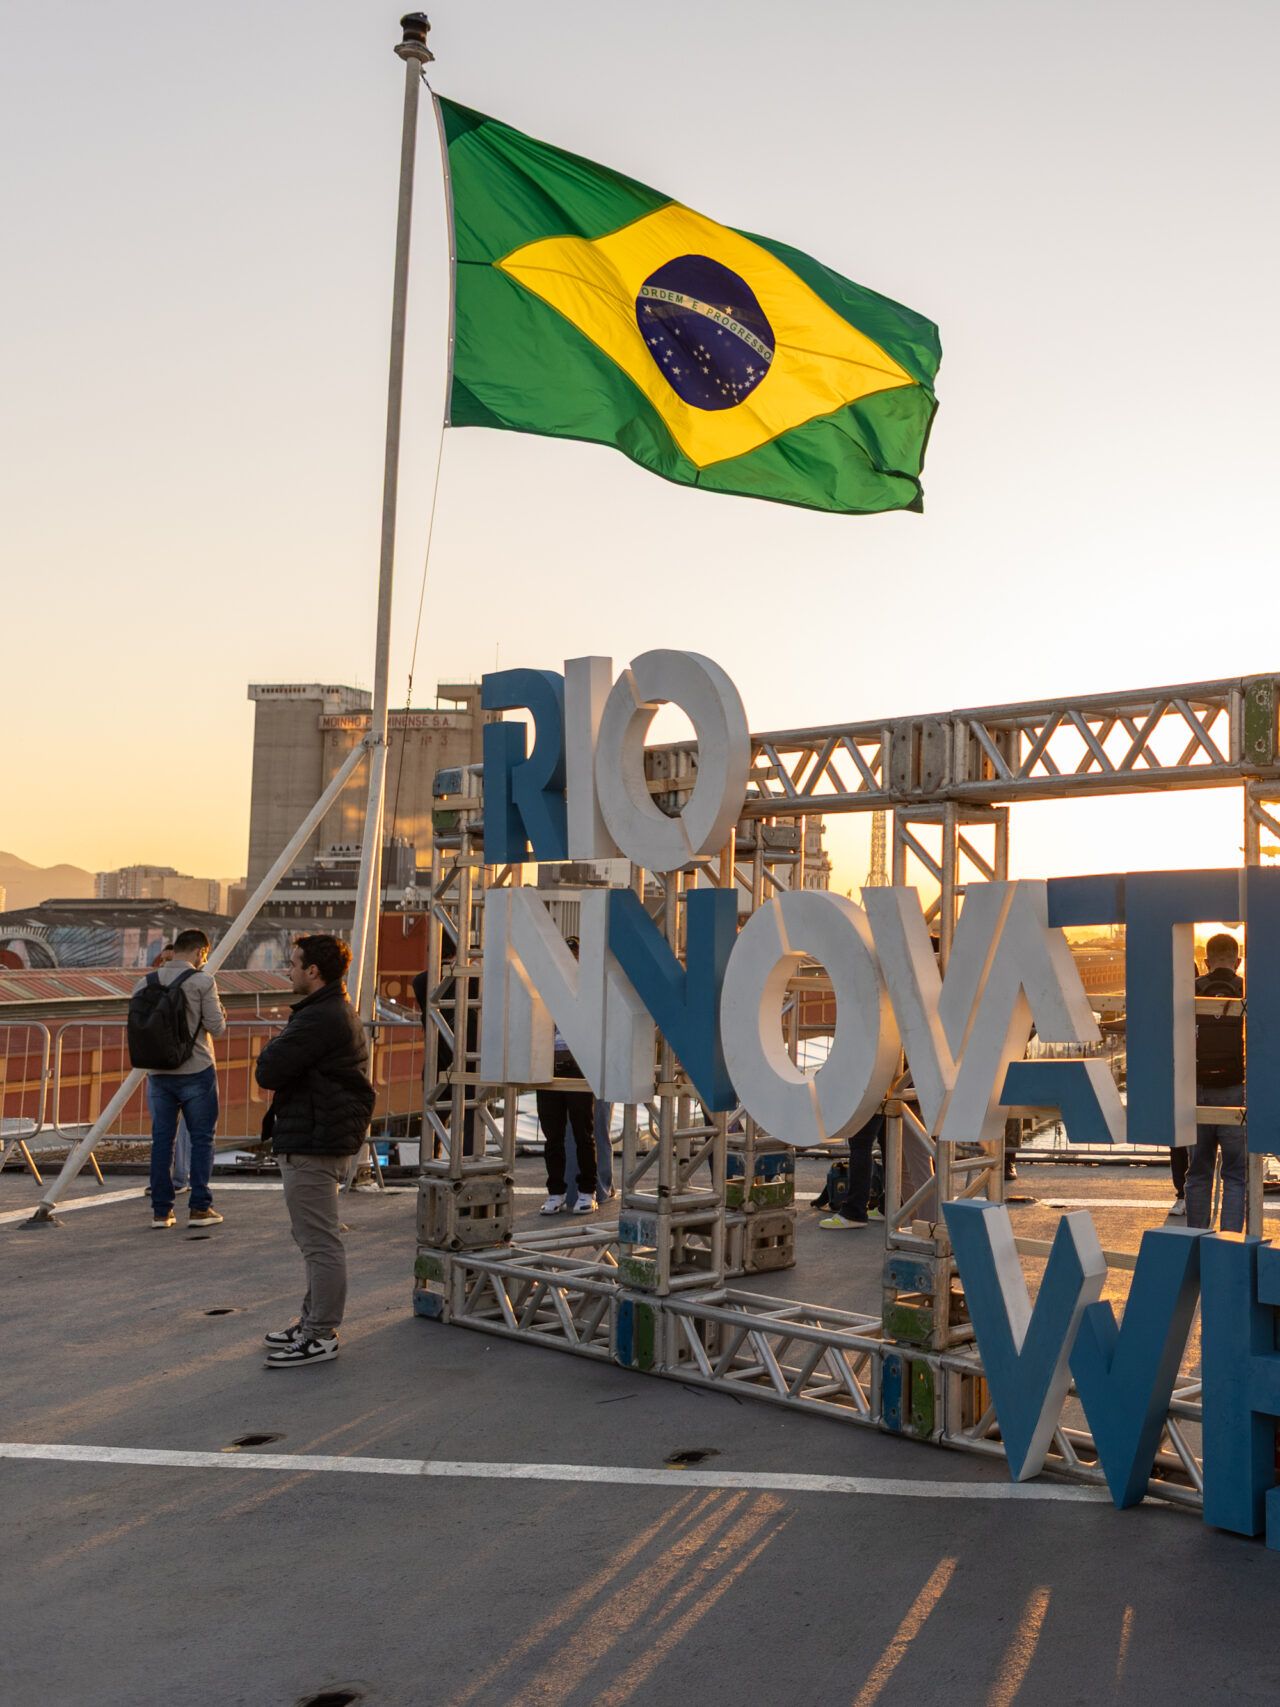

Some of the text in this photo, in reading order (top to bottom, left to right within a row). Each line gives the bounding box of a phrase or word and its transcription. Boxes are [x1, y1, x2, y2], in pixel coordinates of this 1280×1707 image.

[641, 287, 772, 361] ORDEM E PROGRESSO
[323, 715, 361, 728] MOINHO
[366, 715, 429, 727] FMINENSE
[481, 648, 751, 872] RIO
